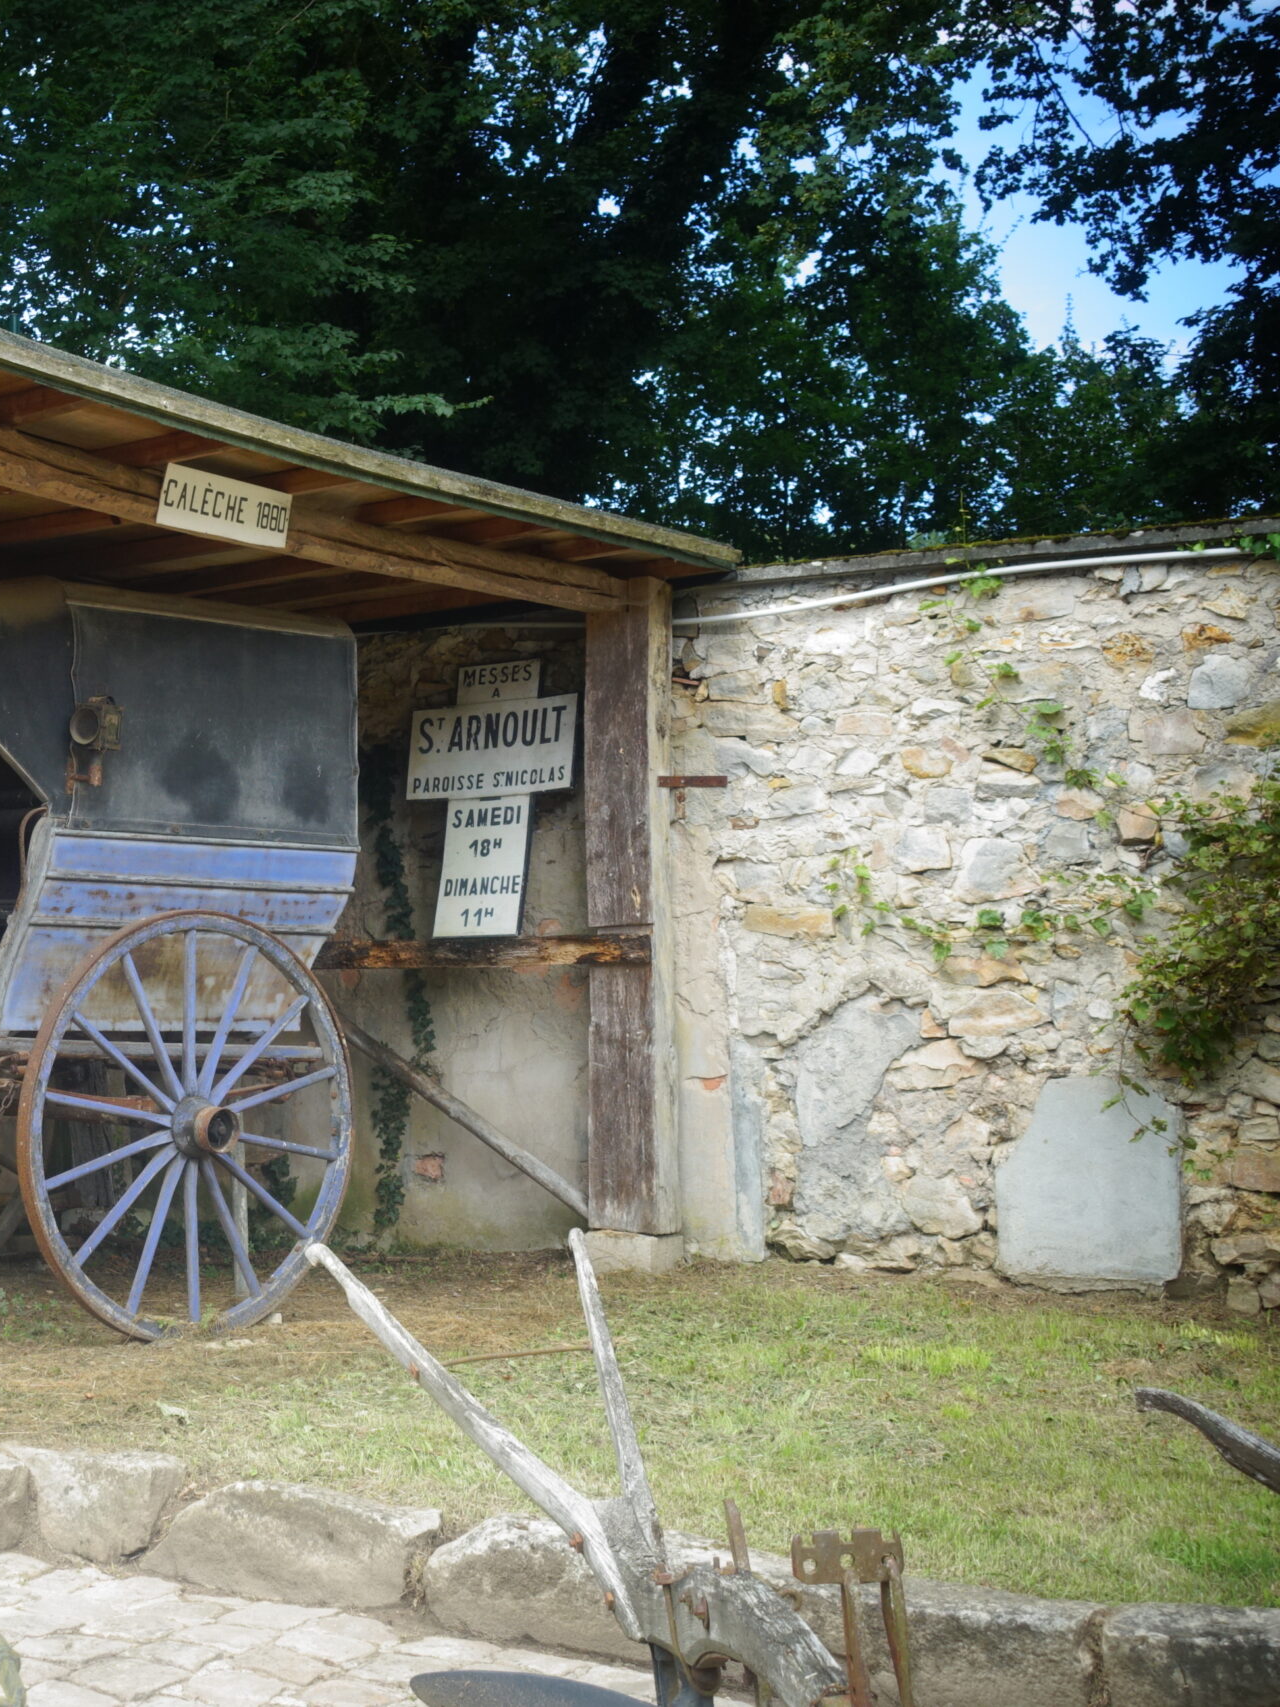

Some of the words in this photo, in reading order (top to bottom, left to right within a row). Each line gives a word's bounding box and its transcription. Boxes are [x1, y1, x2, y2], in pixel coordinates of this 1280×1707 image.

[164, 479, 248, 524] CALÈCHE
[256, 501, 287, 533] 1880
[463, 664, 532, 687] MESSES
[491, 688, 500, 698] A
[448, 705, 567, 753] ARNOULT
[413, 773, 485, 794] PAROISSE
[505, 765, 565, 787] NICOLAS
[452, 805, 522, 829] SAMEDI
[444, 875, 521, 897] DIMANCHE
